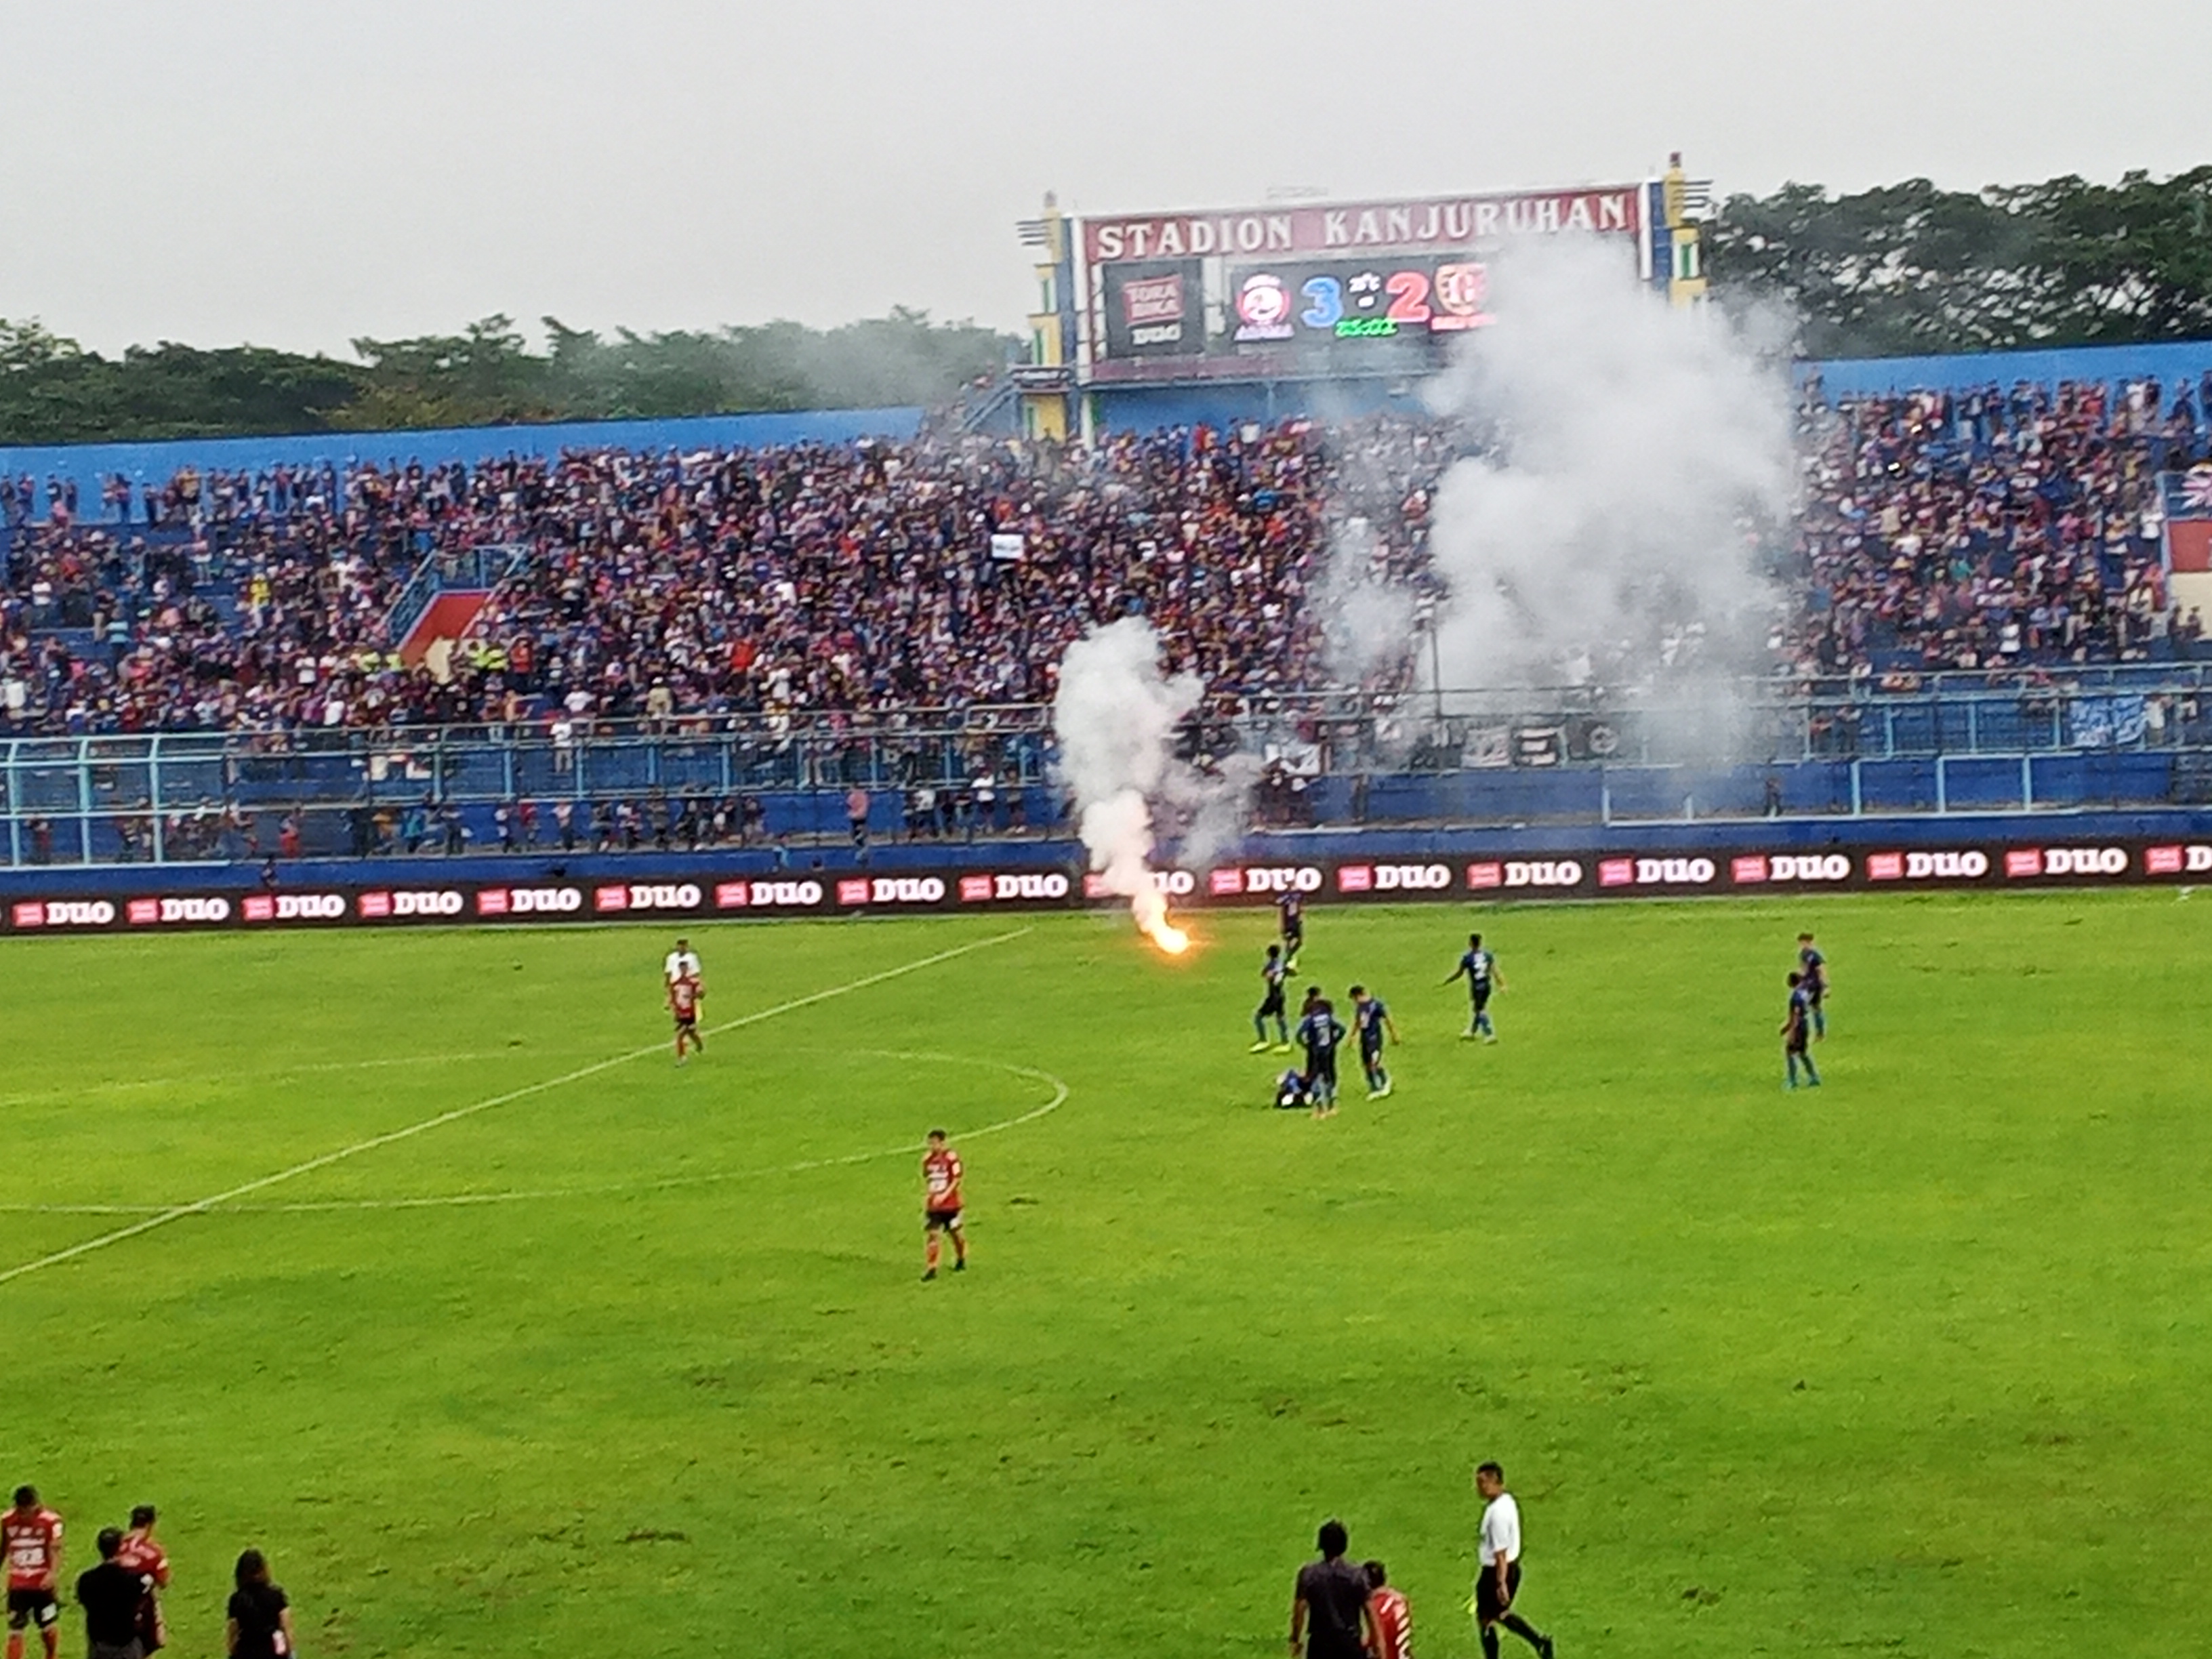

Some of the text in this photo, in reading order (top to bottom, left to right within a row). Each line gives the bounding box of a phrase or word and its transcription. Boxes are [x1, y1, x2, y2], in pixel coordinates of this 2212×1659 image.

[1097, 194, 1626, 260] STADION KANJURUHAN
[1300, 271, 1431, 329] 3 2
[1637, 859, 1714, 882] DUO
[1771, 855, 1849, 879] DUO
[1907, 853, 1986, 876] DUO
[2046, 849, 2126, 873] DUO
[1149, 870, 1195, 895] UO
[1247, 868, 1321, 890] DUO
[1375, 865, 1450, 888] DUO
[1506, 862, 1580, 884] DUO
[630, 885, 700, 907] DUO
[752, 882, 821, 904] DUO
[874, 879, 943, 901] DUO
[996, 875, 1067, 897] DUO
[161, 899, 228, 920] DUO
[276, 896, 344, 917] DUO
[394, 892, 462, 914] DUO
[512, 888, 580, 911] DUO
[47, 902, 113, 923] DUO
